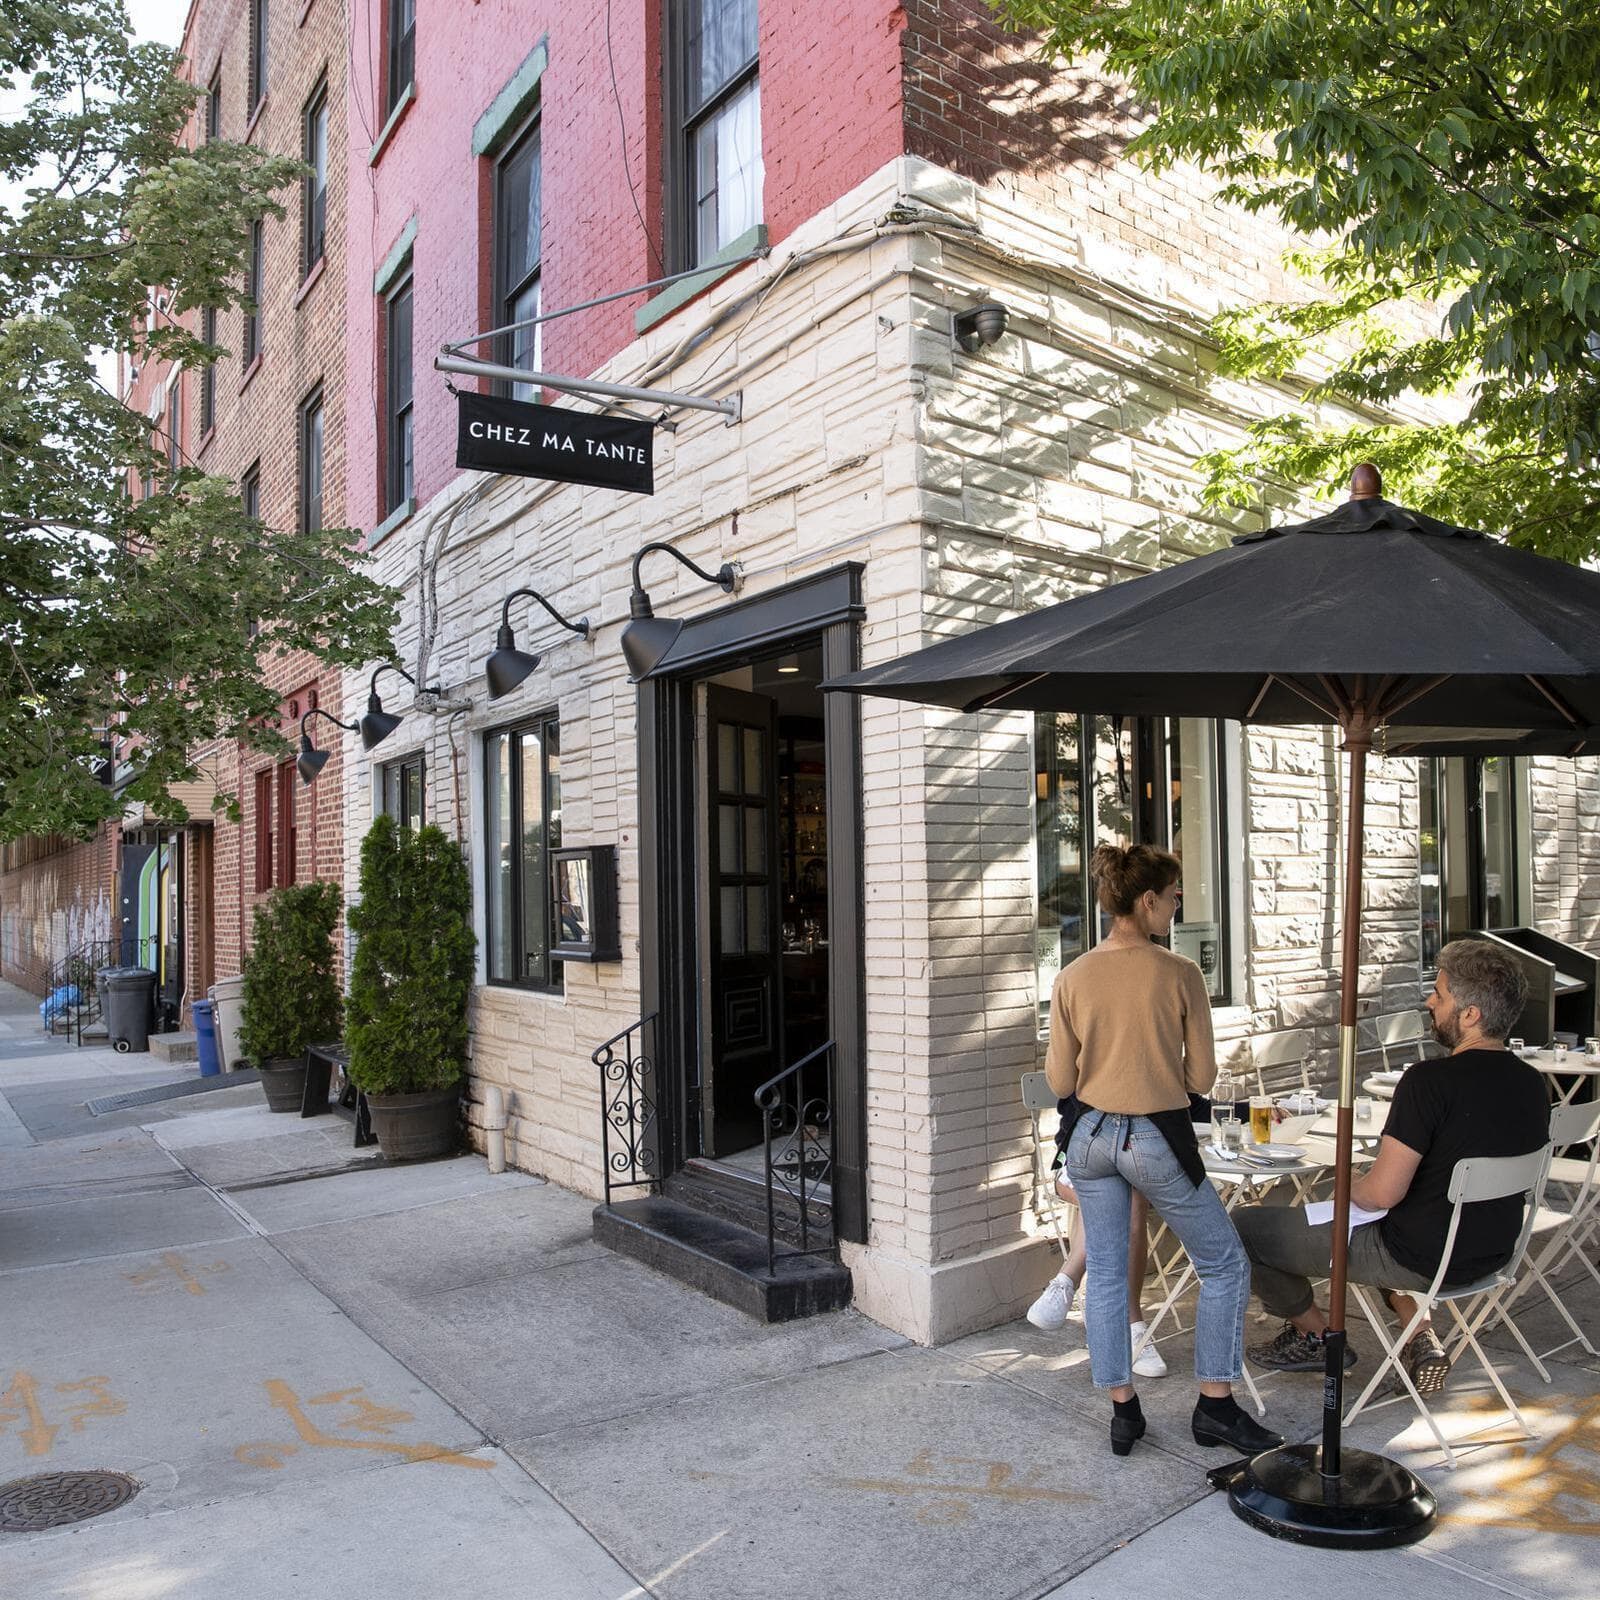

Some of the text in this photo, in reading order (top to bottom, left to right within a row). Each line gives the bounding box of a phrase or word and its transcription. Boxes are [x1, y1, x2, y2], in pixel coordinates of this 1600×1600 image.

[469, 422, 646, 464] CHEZ MA TANTE
